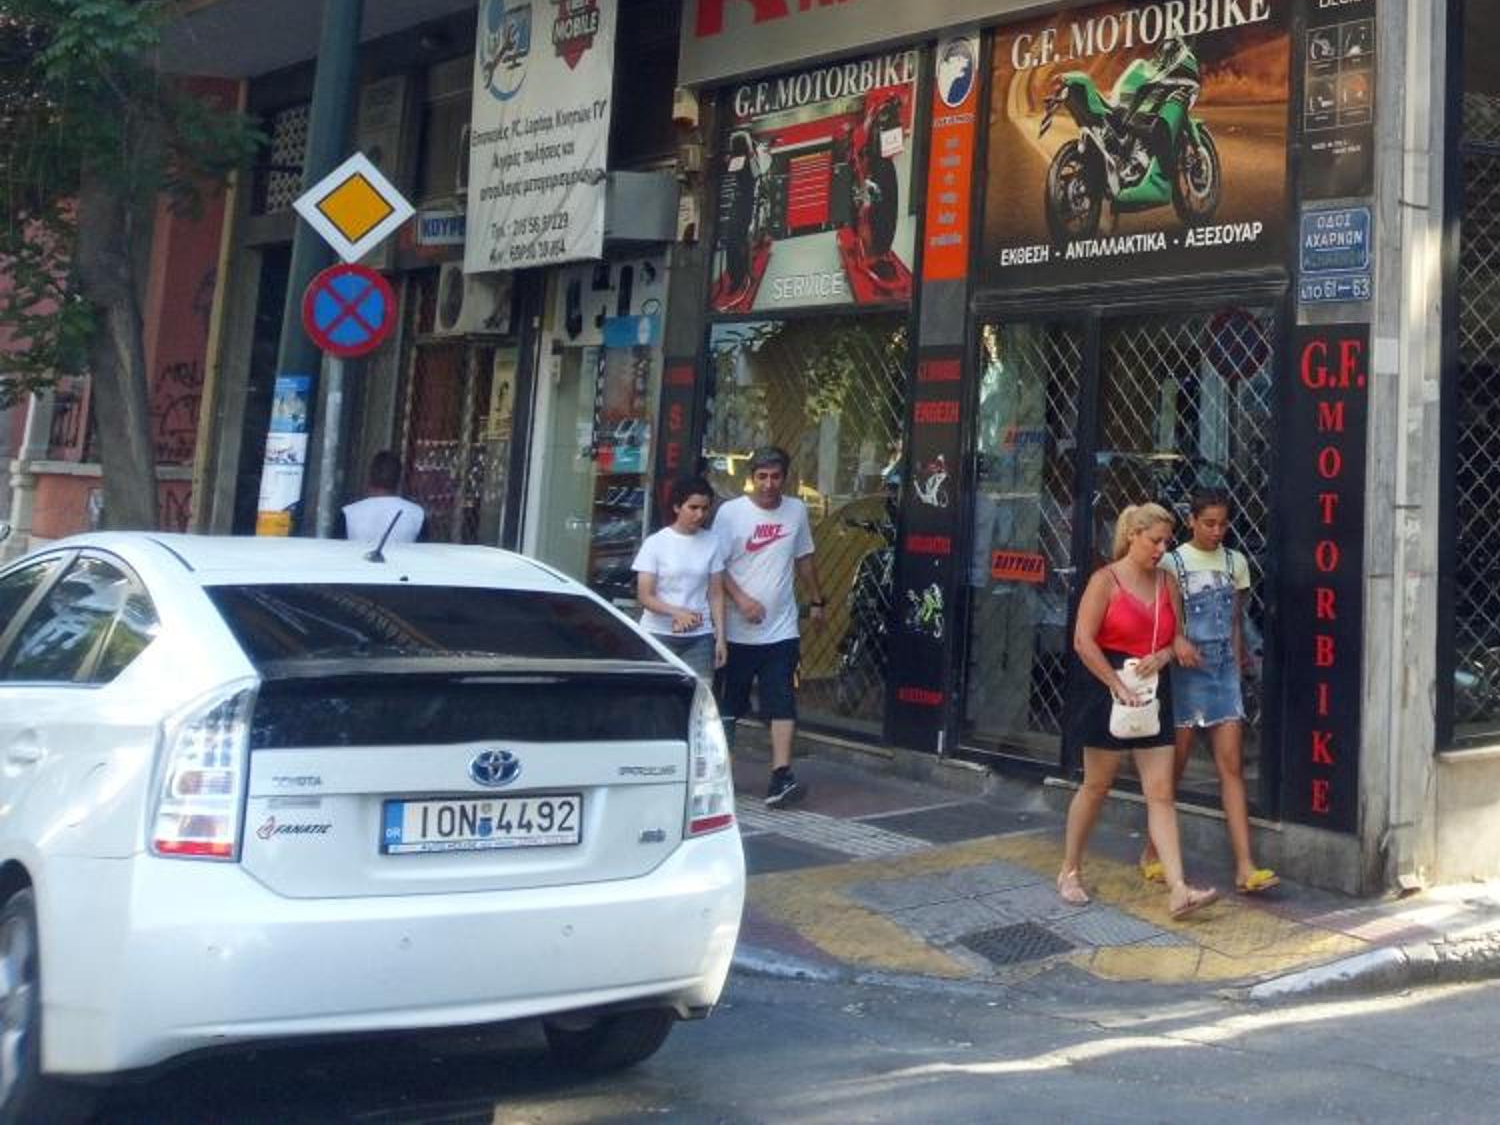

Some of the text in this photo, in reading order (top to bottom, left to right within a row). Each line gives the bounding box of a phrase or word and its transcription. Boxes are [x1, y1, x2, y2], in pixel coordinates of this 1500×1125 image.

[1011, 27, 1061, 71] G.F.
[735, 49, 919, 118] G.F. MOTORBIKE
[1305, 230, 1364, 249] ΑΧΑΡΝΩΝ
[1317, 213, 1351, 229] ΟΔΟΣ
[1000, 221, 1264, 267] ΕΚΘΕΣΗ ΑΝΤΑΛΛΑΚΤΙΚΑ ΑΞΕΣΟΥΑΡ
[771, 272, 846, 301] SERVICE
[1300, 338, 1365, 389] G.F.
[753, 522, 784, 540] NIKE
[1310, 401, 1346, 814] MOTORBIKE
